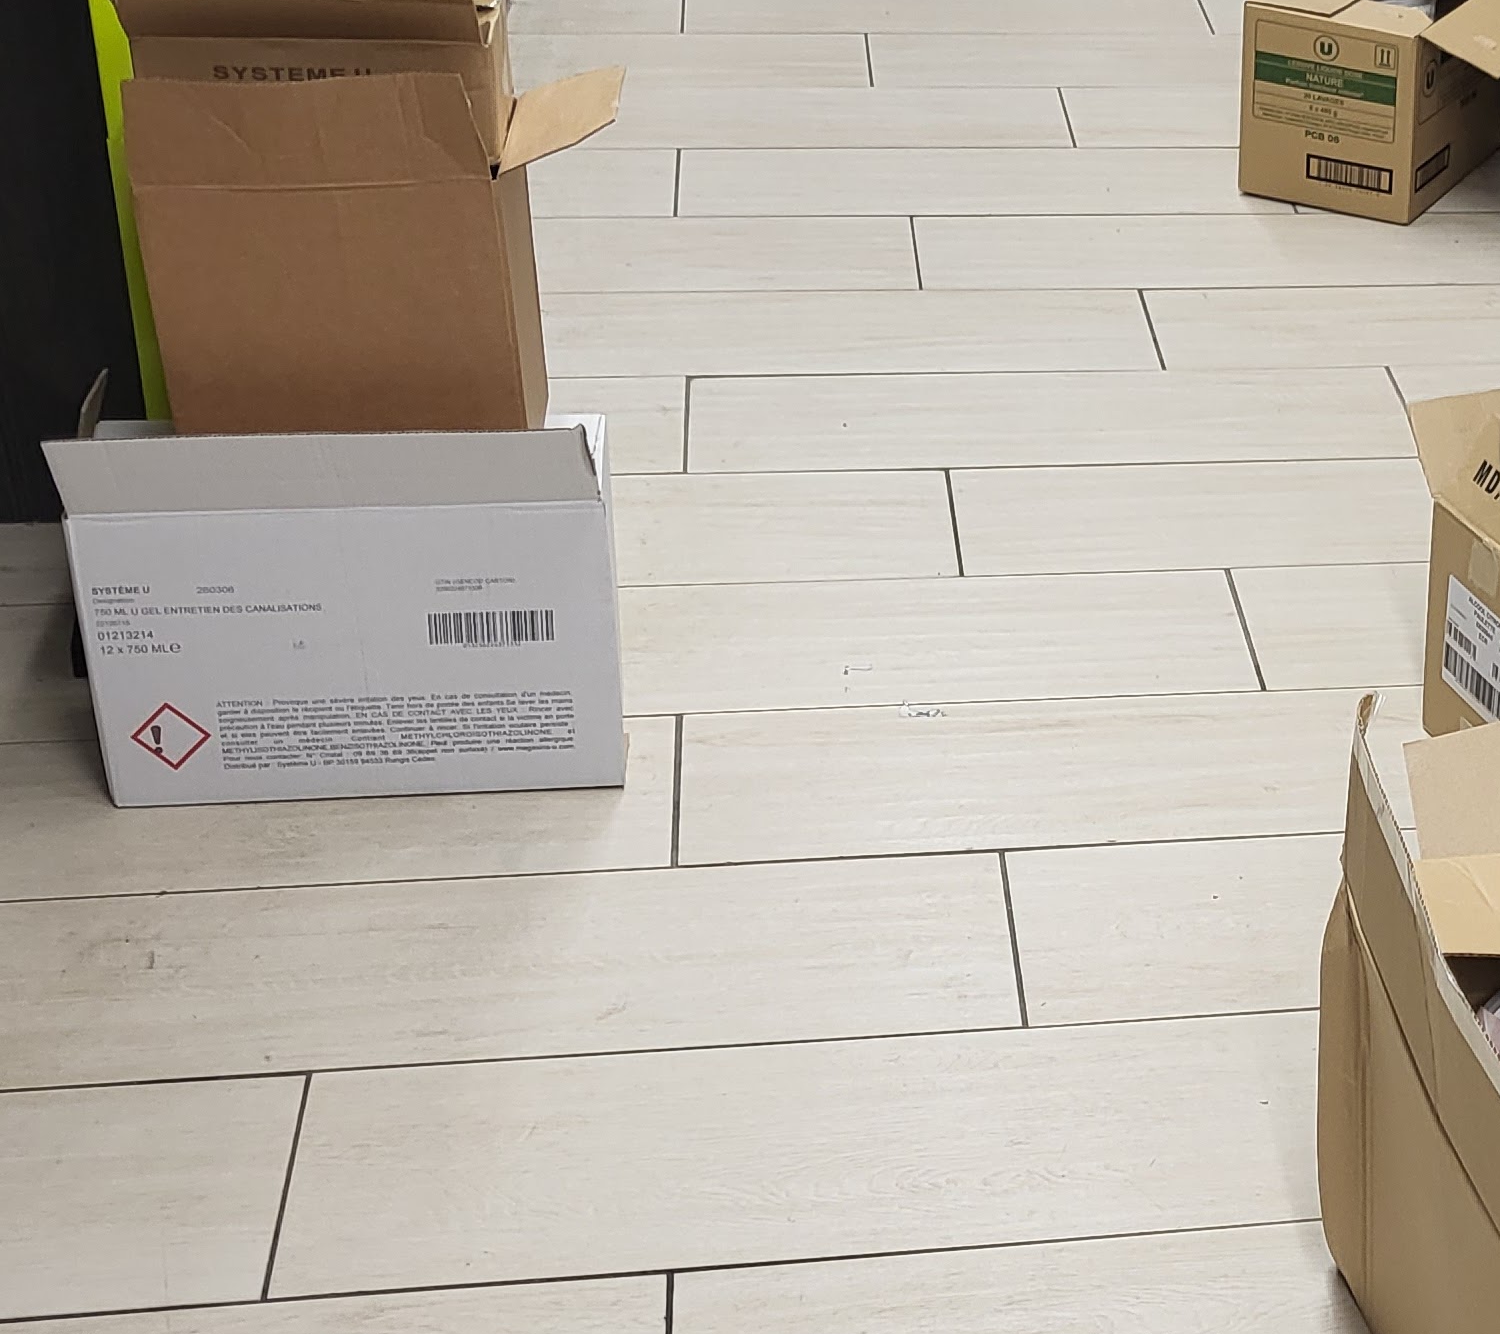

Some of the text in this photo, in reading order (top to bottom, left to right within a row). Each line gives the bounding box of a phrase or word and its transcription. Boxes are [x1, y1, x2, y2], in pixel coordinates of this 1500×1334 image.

[1306, 73, 1344, 88] NATURE
[1304, 129, 1325, 142] PCB
[142, 586, 150, 595] U
[114, 607, 128, 616] ML
[141, 606, 162, 616] GEL
[164, 605, 220, 615] ENTRETIEN
[223, 604, 243, 614] DES
[245, 602, 322, 613] CANALISATIONS
[127, 643, 148, 654] 750
